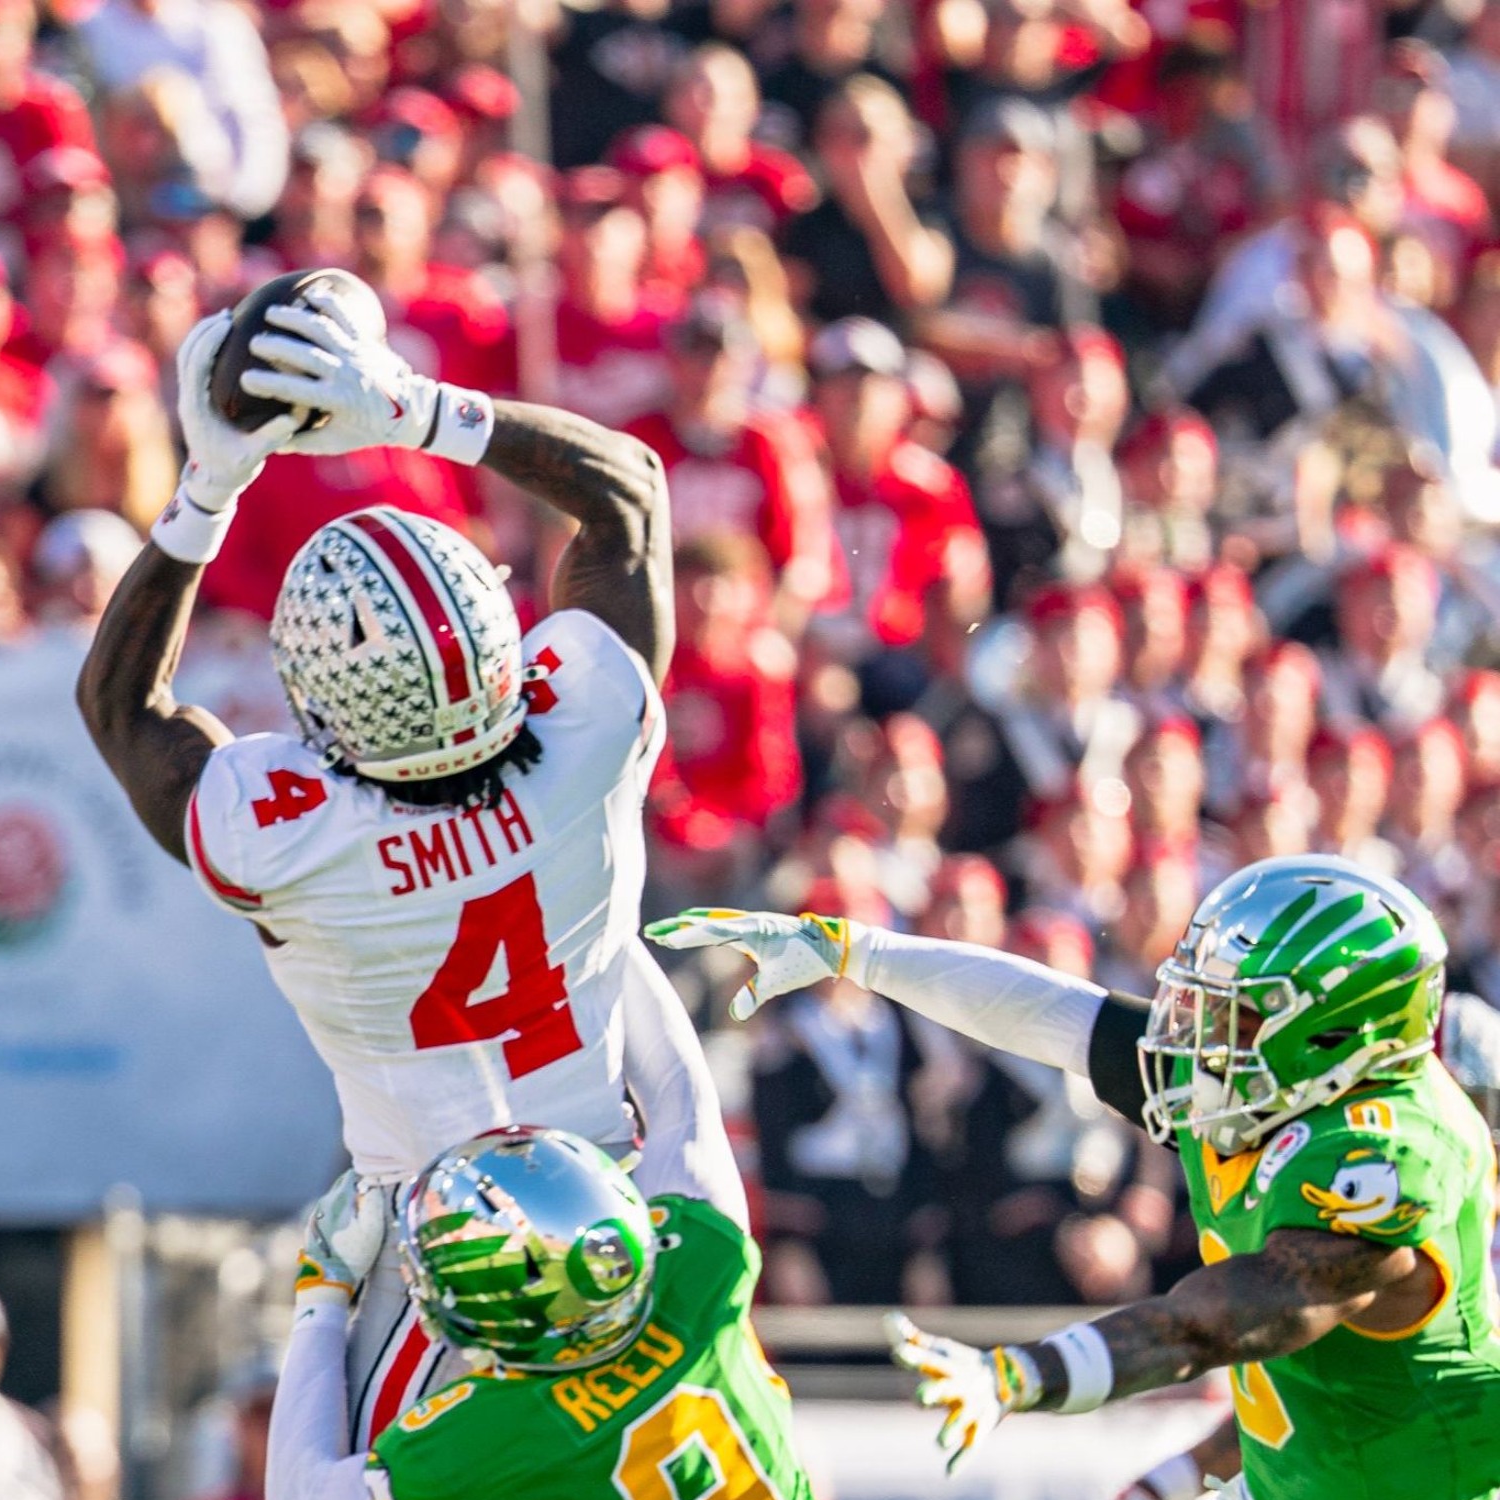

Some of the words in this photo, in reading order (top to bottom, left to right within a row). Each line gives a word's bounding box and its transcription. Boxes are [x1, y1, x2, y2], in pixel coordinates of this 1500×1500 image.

[252, 769, 328, 828] 4
[377, 788, 533, 896] SMITH
[410, 872, 583, 1079] 4
[552, 1322, 684, 1423] REED
